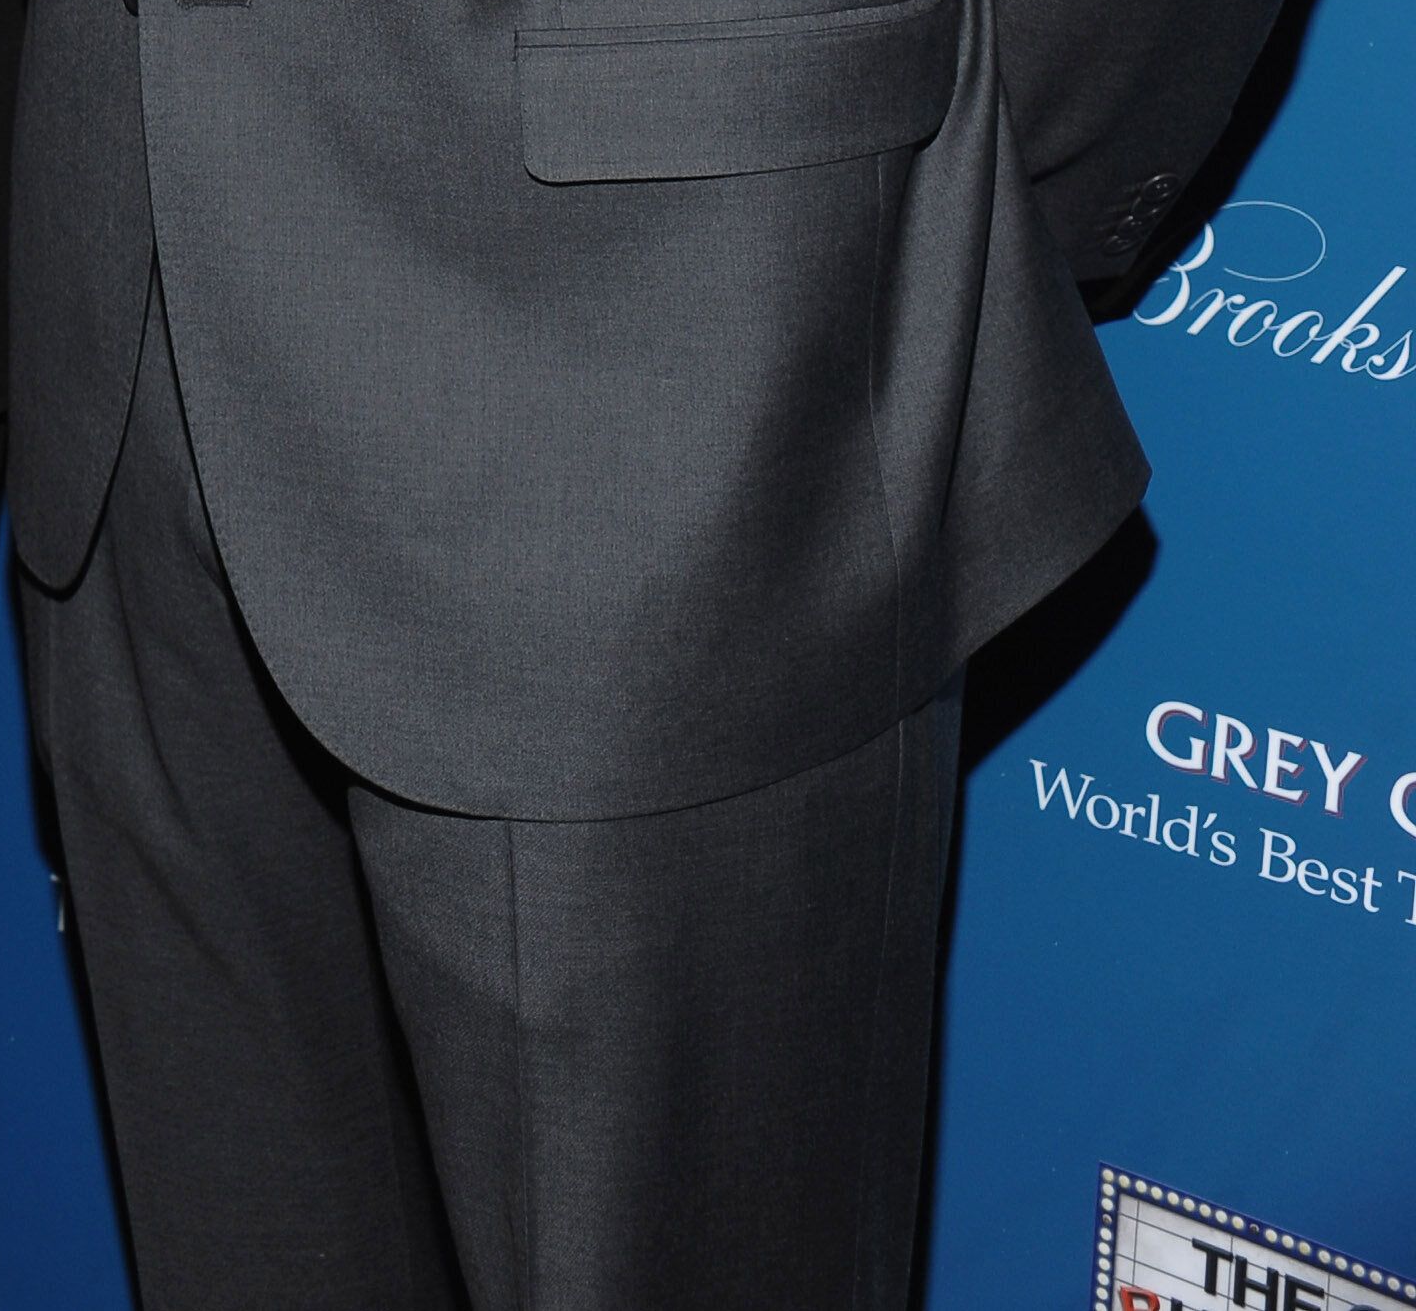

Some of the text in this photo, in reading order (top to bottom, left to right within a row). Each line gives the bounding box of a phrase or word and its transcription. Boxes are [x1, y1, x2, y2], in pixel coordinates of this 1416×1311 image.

[1145, 700, 1366, 816] GREY
[1029, 759, 1238, 867] World's
[1258, 828, 1382, 913] Best
[1191, 1237, 1325, 1311] THE
